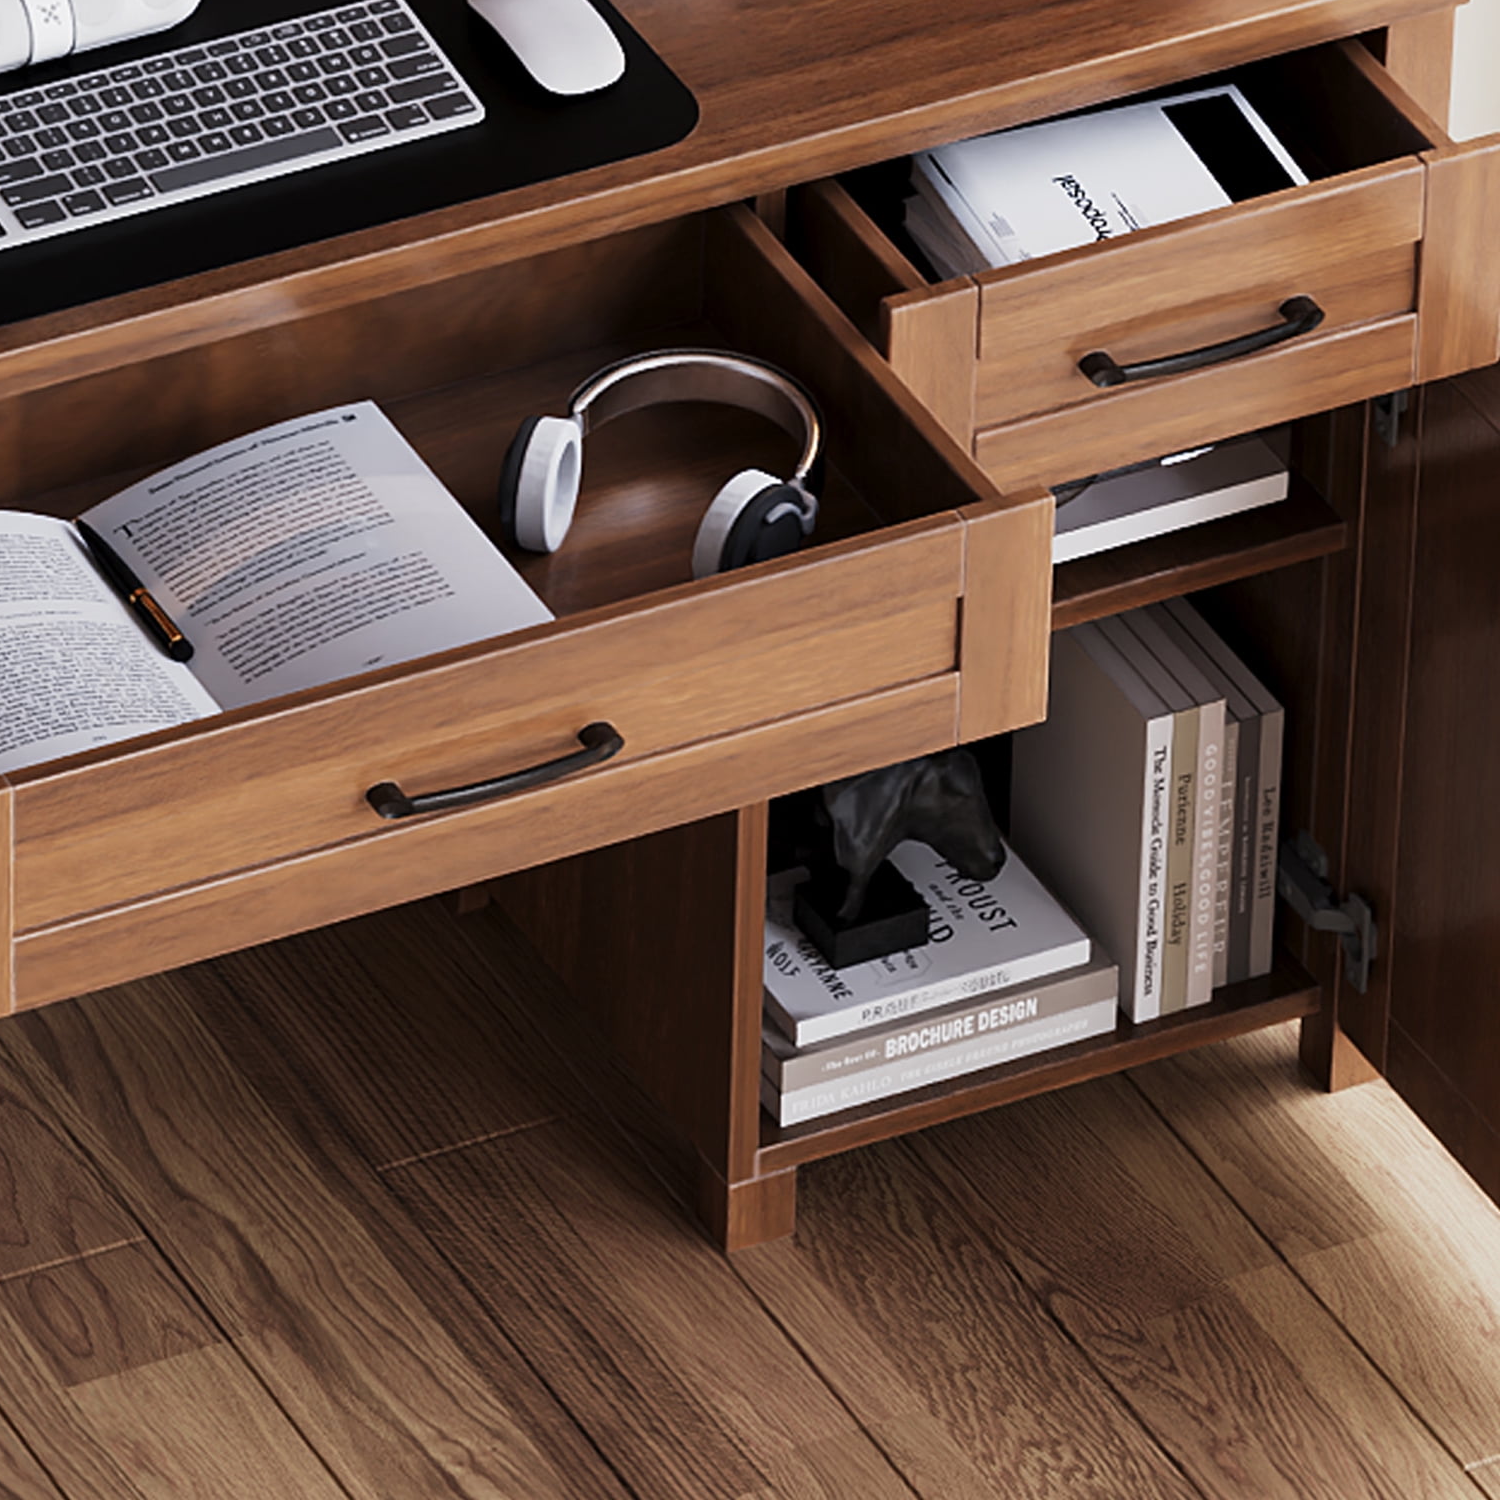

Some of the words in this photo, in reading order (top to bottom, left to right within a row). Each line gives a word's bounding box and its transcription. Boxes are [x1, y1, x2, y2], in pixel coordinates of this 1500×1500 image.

[1204, 743, 1218, 801] GOOD
[1167, 882, 1188, 946] Holiday
[1198, 867, 1212, 925] GOOD
[884, 1015, 975, 1060] BROCHURE
[977, 996, 1038, 1032] DESIGN
